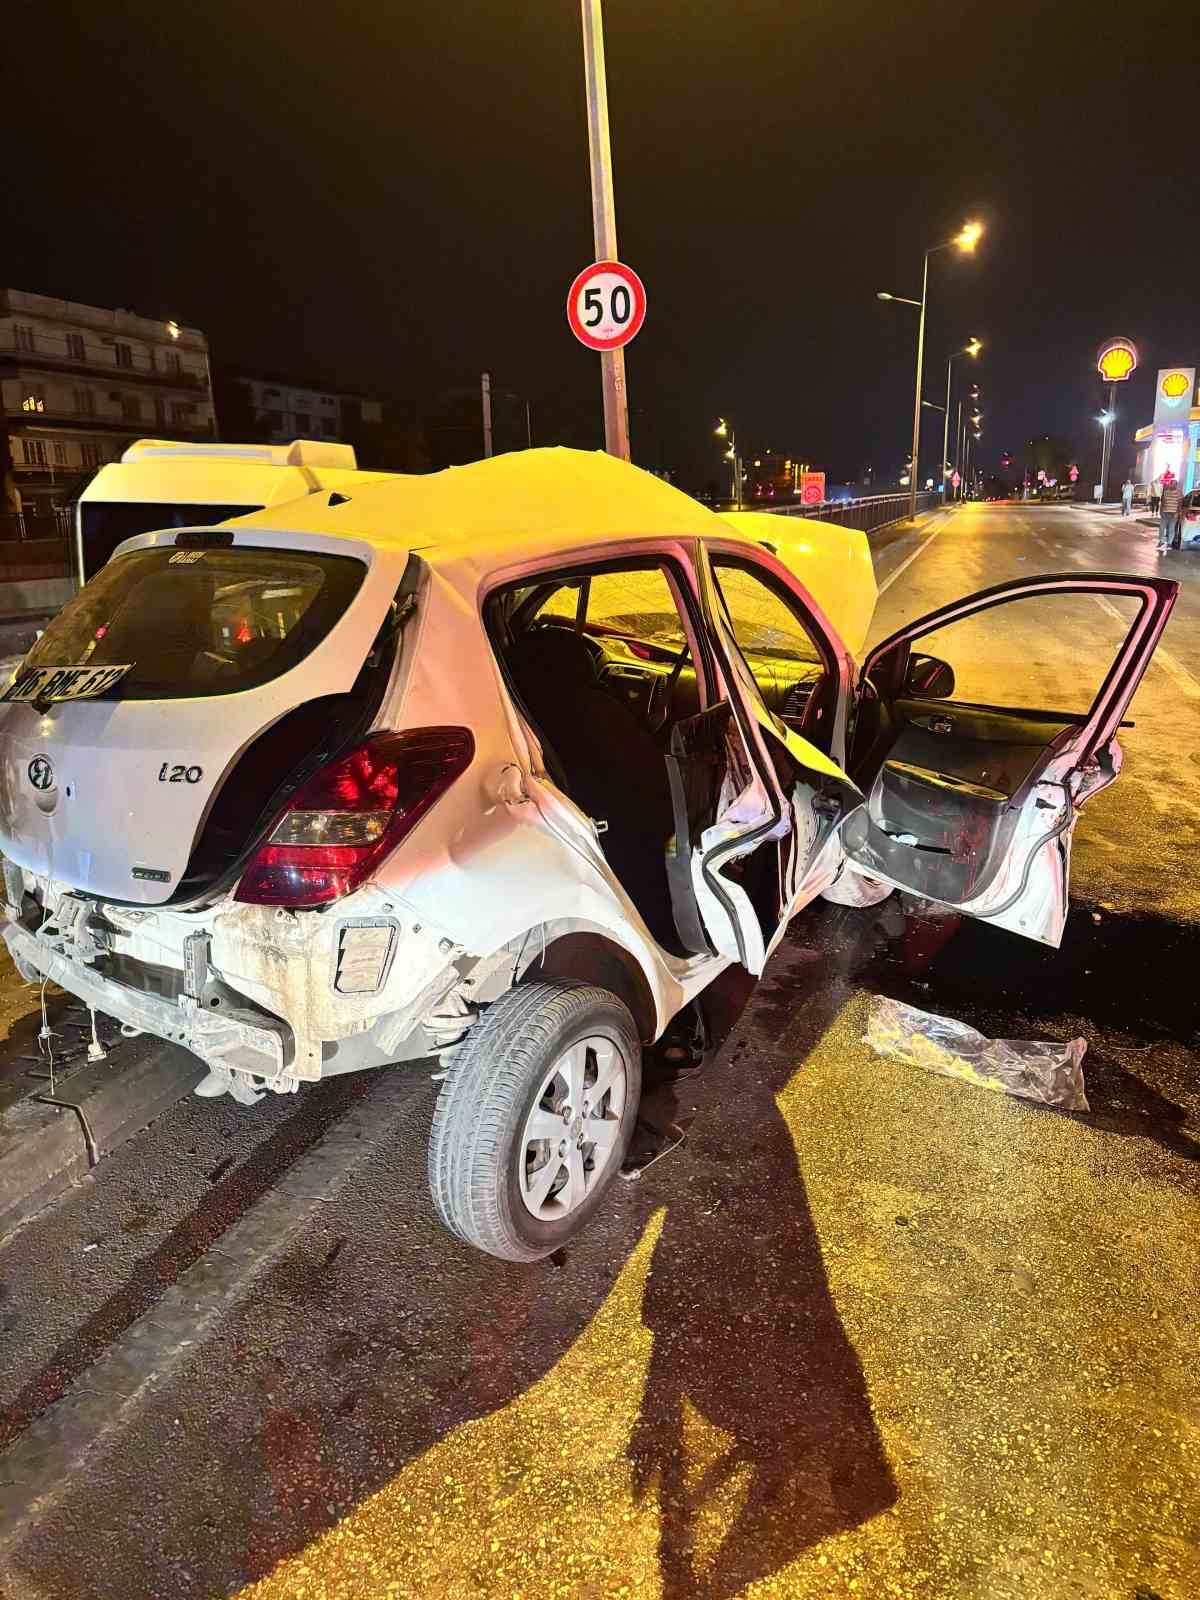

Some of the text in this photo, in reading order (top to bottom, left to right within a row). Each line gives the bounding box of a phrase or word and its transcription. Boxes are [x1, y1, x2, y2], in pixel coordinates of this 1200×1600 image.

[585, 285, 630, 326] 50
[15, 670, 47, 697] 16
[159, 762, 202, 783] i20
